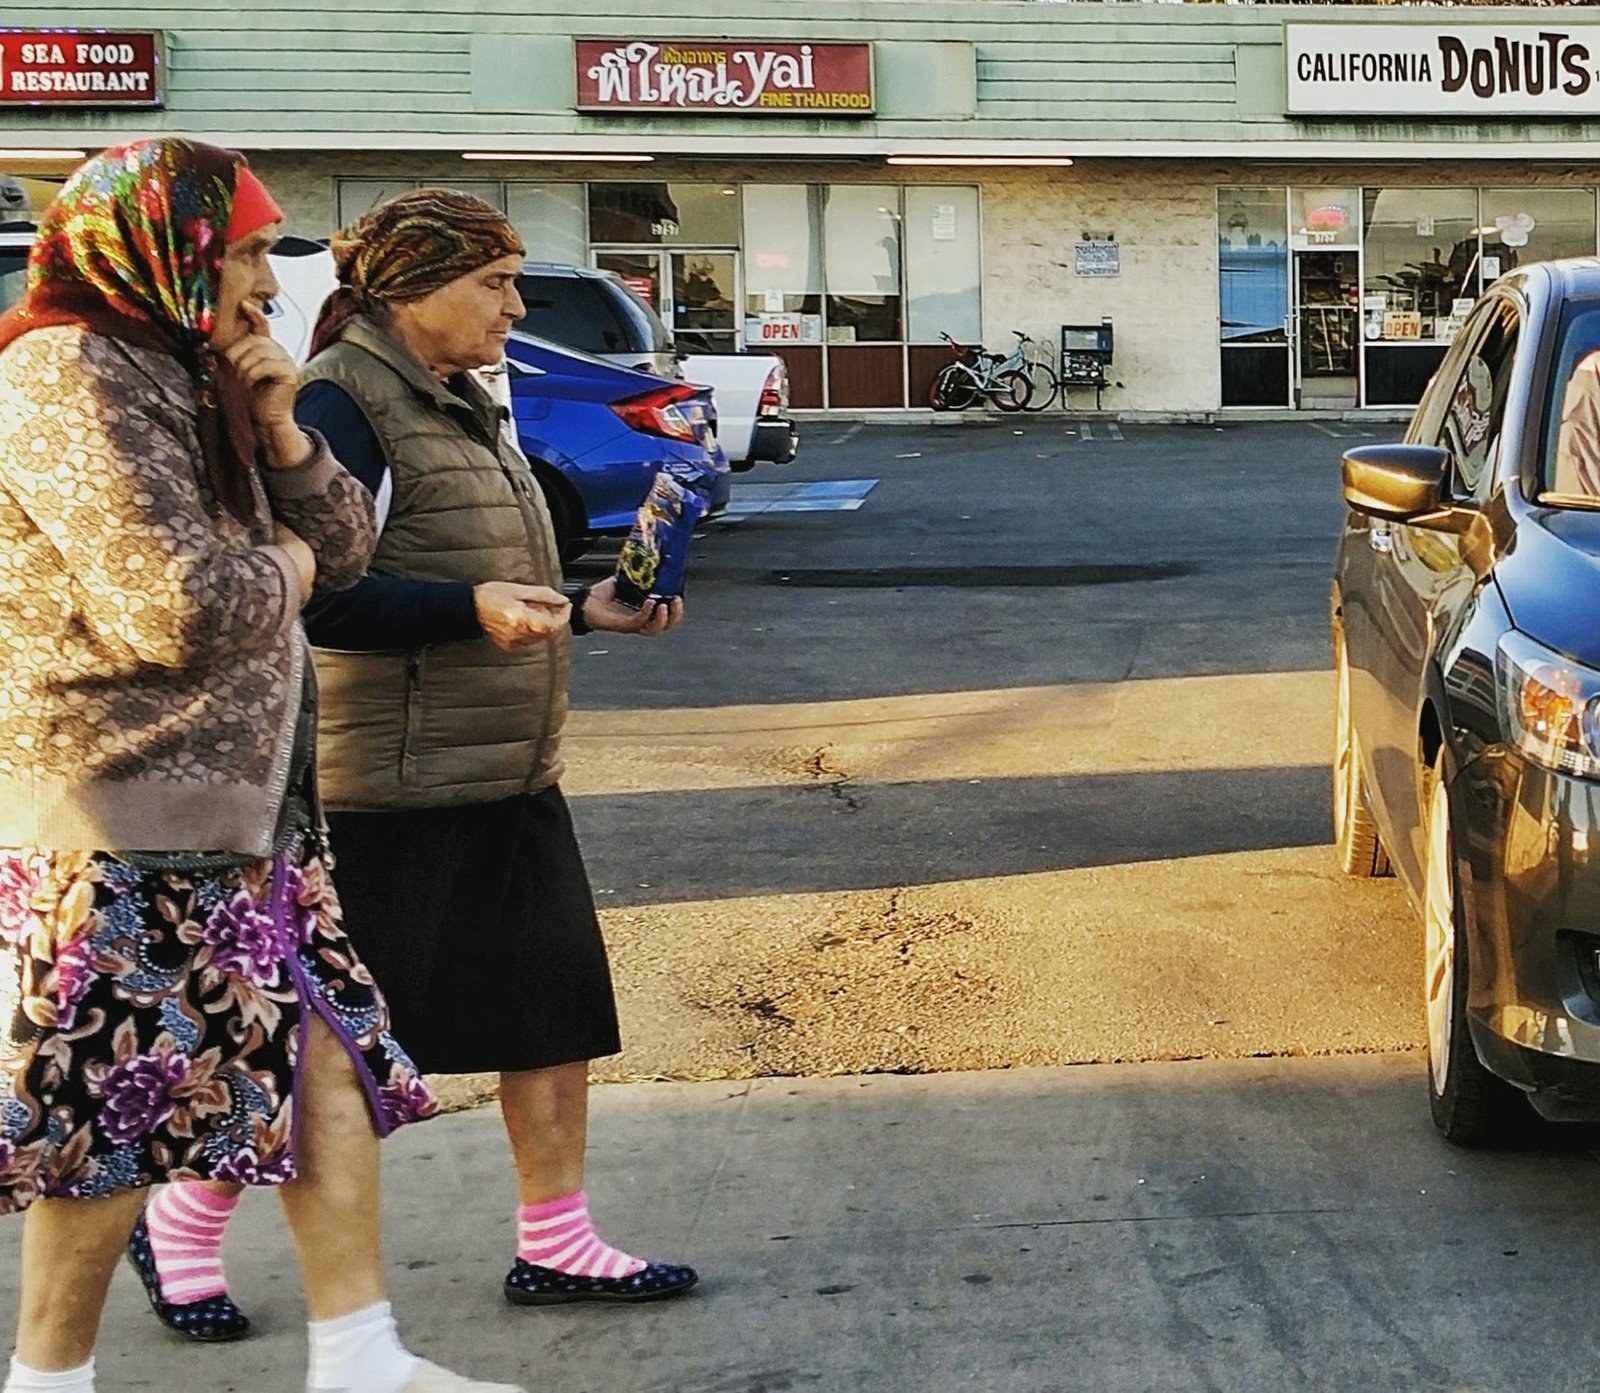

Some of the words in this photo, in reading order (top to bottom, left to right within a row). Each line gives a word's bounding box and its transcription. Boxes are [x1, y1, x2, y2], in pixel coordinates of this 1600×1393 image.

[21, 43, 65, 64] SEA
[76, 44, 134, 64] FOOD
[1297, 53, 1432, 82] CALIFORNIA
[1438, 32, 1590, 98] DONUTS
[11, 71, 149, 91] RESTAURANT
[760, 92, 792, 107] FINE
[793, 92, 830, 107] THAI
[832, 93, 870, 108] FOOD
[762, 323, 800, 339] OPEN
[1385, 322, 1419, 337] OPEN
